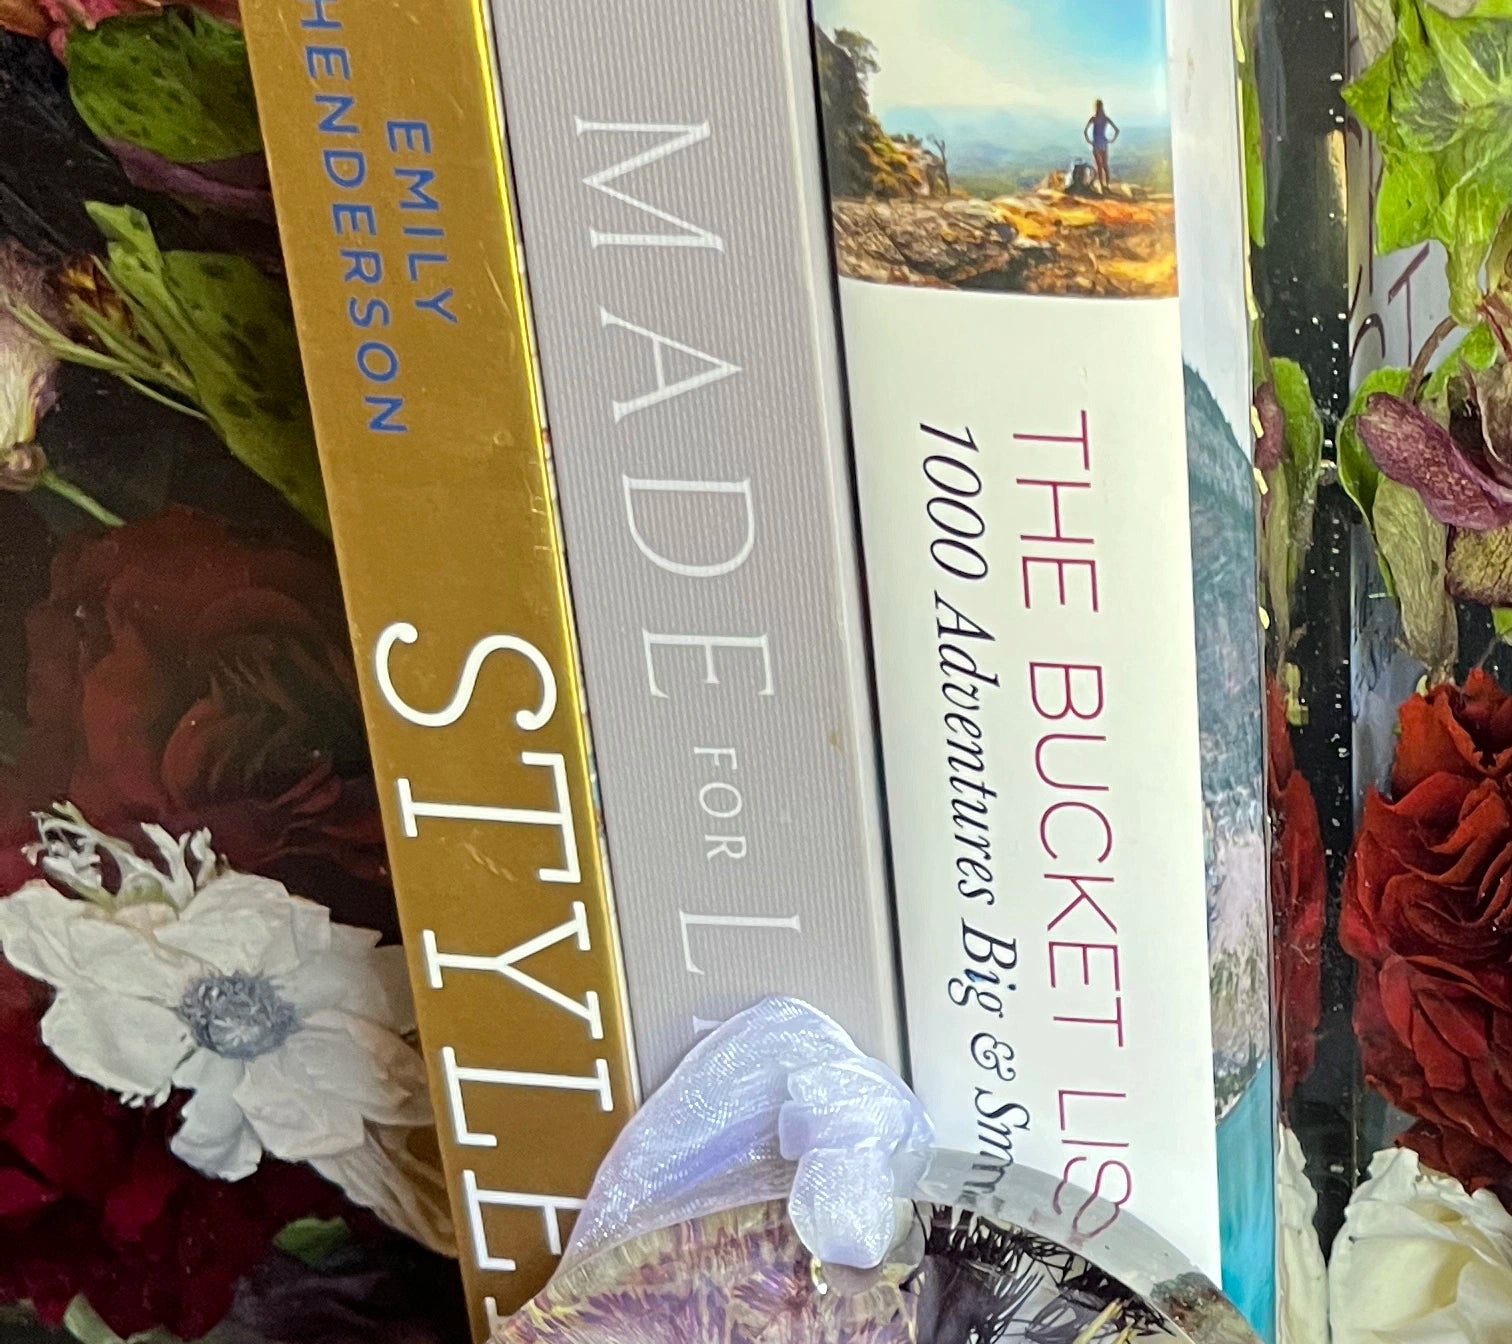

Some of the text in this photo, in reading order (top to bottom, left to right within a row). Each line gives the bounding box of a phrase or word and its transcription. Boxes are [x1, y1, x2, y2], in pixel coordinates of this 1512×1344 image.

[386, 118, 458, 325] EMILY
[574, 114, 775, 700] MADE
[693, 745, 748, 863] FOR
[919, 422, 989, 581] 1000
[933, 589, 1001, 907] Adventures
[1012, 409, 1133, 1246] THE BUCKET LIS
[375, 621, 614, 1338] STYLE
[947, 917, 1018, 1019] Big
[969, 1031, 1017, 1082] &
